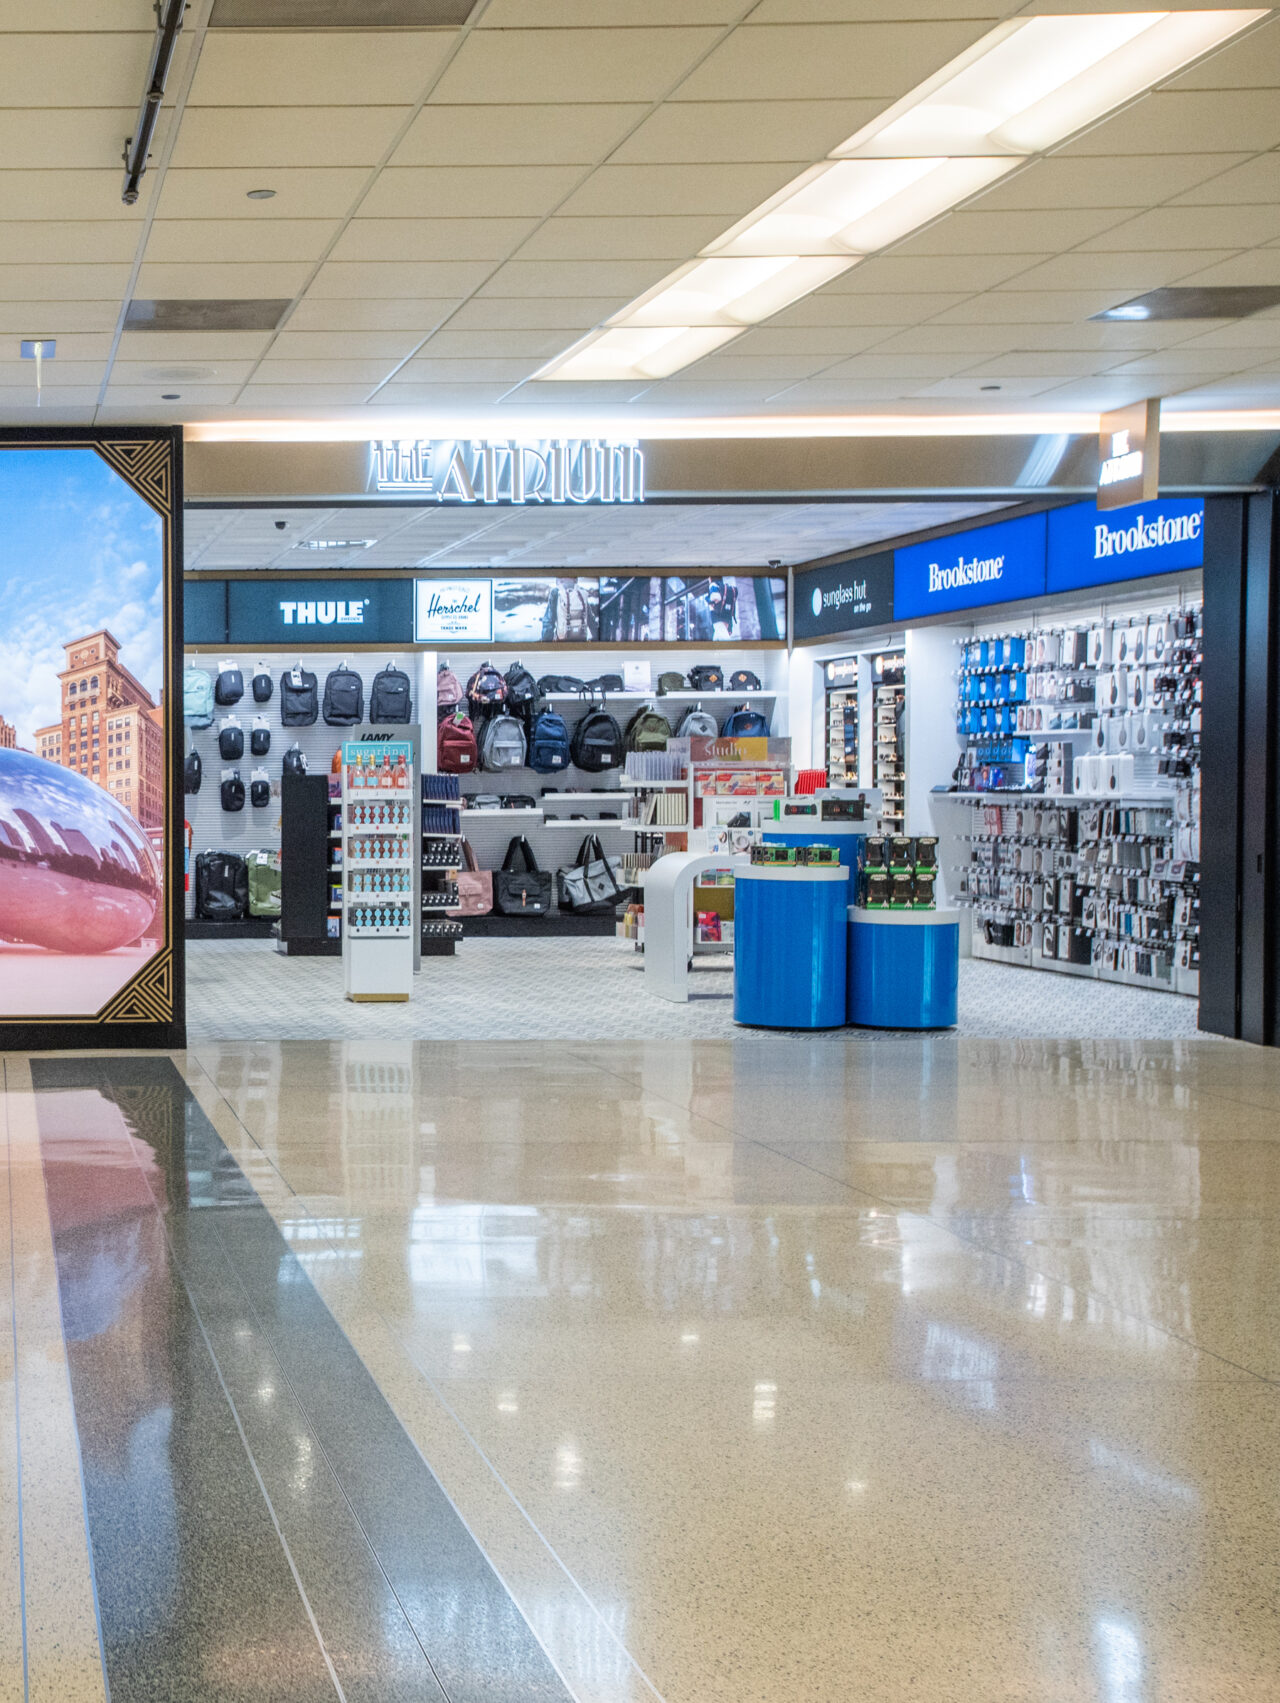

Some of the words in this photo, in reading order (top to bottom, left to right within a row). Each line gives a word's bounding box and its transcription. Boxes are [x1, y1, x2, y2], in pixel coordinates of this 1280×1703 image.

[373, 446, 432, 490] THE
[437, 446, 645, 503] ATRIUM
[1094, 511, 1203, 559] Brookstone
[928, 555, 1004, 592] Brookstone
[427, 593, 481, 619] Herschel
[823, 584, 853, 610] sunglass
[854, 579, 867, 600] hut
[279, 601, 364, 624] THULE
[360, 733, 395, 741] LAMY
[350, 745, 405, 759] sugarfina
